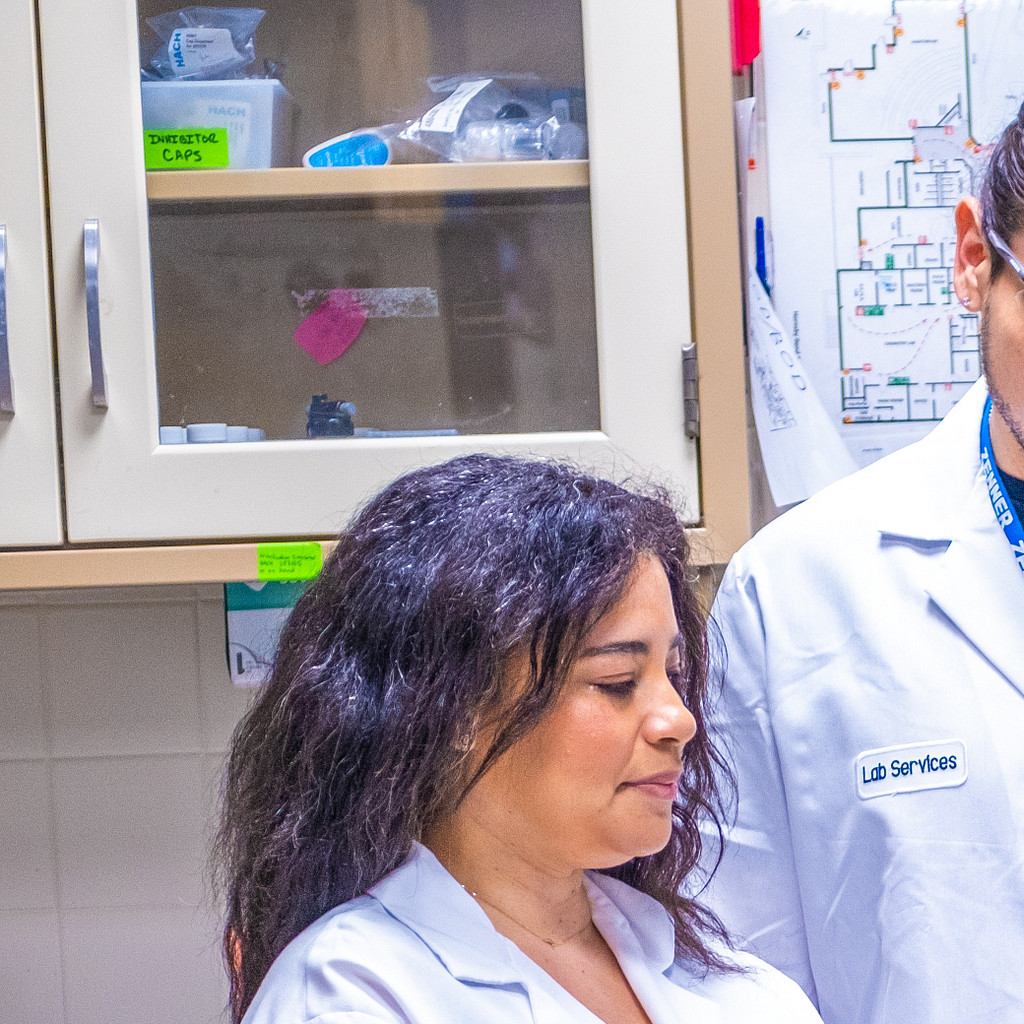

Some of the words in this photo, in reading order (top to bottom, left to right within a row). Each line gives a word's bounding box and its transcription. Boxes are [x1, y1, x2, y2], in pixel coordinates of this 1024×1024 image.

[173, 33, 185, 67] HACH
[148, 132, 219, 145] INHIBITOR
[162, 148, 203, 162] CAPS
[861, 758, 888, 784] Lab
[890, 752, 958, 780] Services
